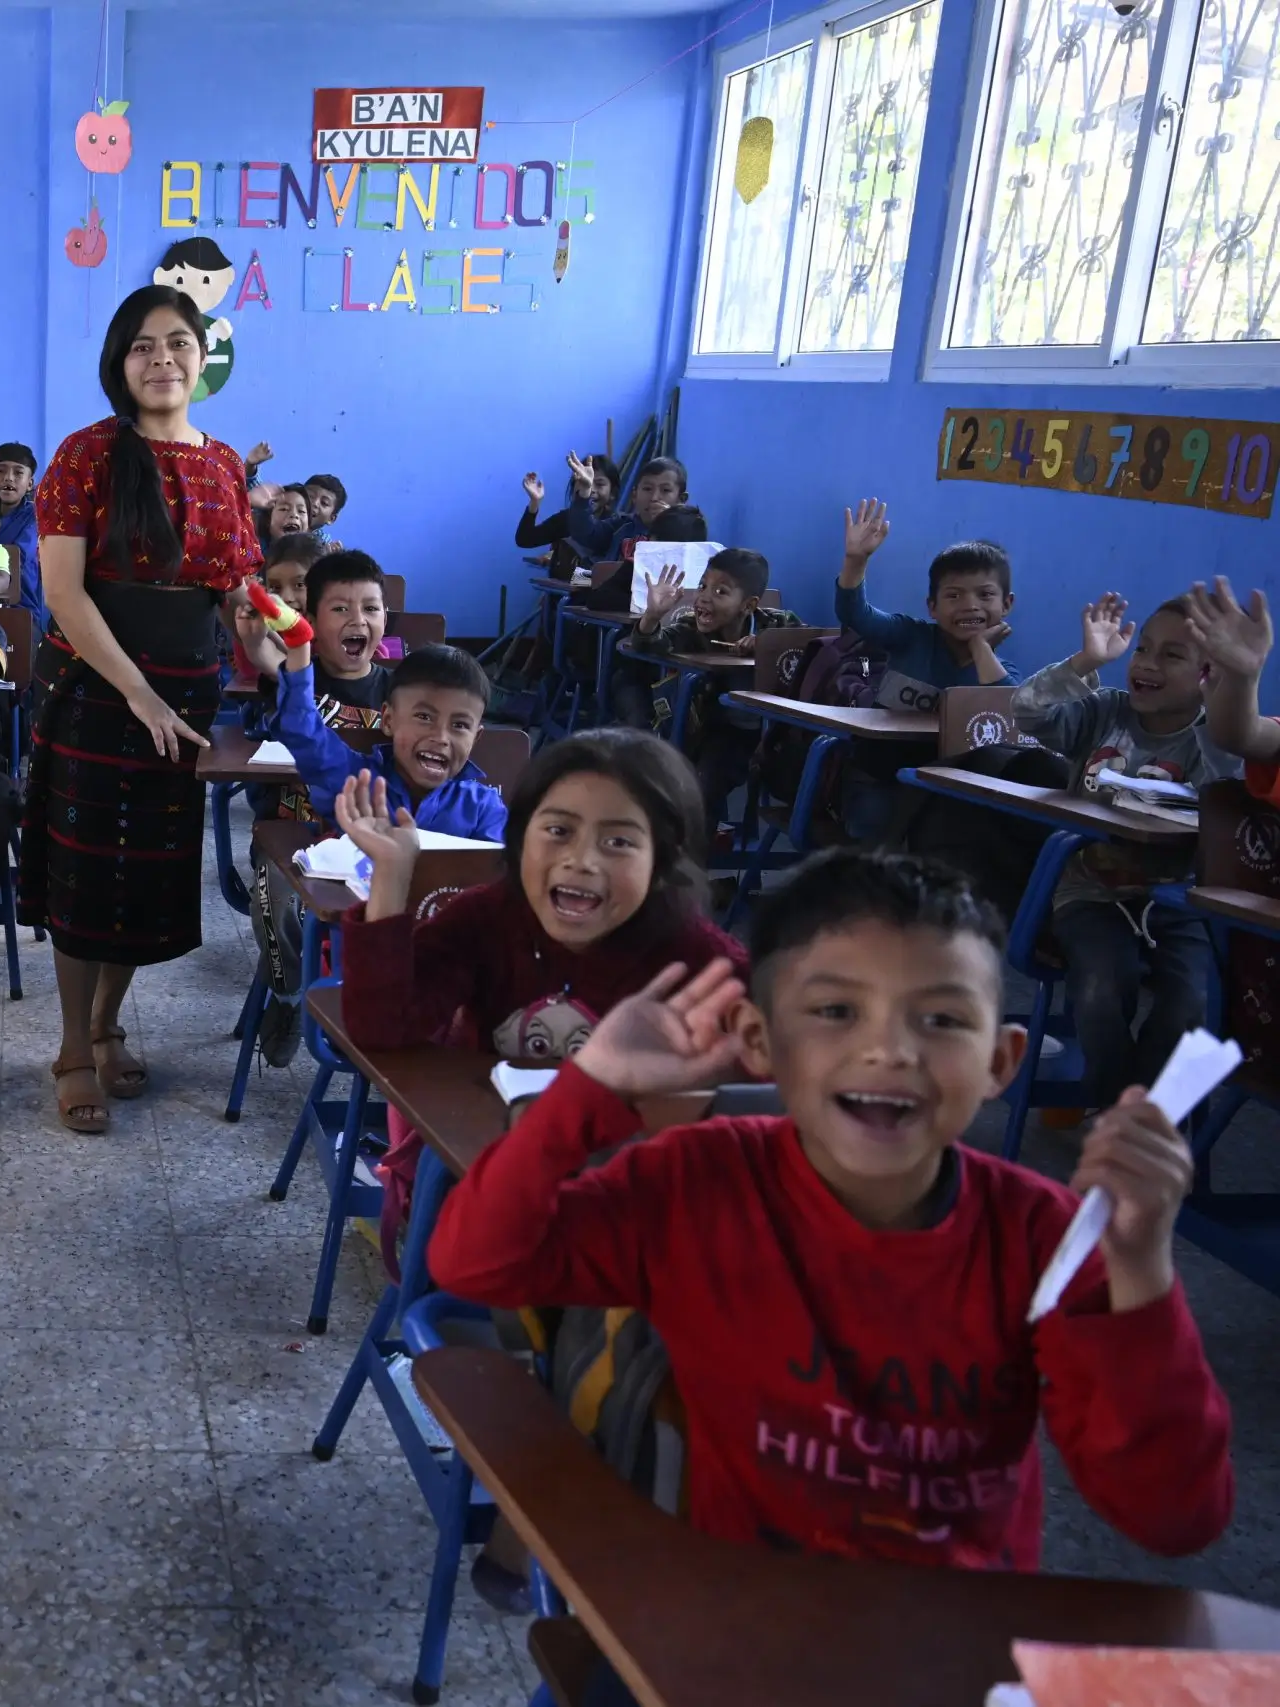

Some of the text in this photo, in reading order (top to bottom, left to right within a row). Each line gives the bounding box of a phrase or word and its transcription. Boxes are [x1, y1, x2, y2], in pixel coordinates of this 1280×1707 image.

[319, 130, 472, 158] KYULENA
[161, 160, 595, 230] BIENVENIDOS
[234, 246, 542, 314] A CLASES
[942, 416, 1270, 505] 1 2 3 4 5 6 7 8 9 10
[257, 876, 271, 918] NIKE
[269, 947, 284, 980] NIKE
